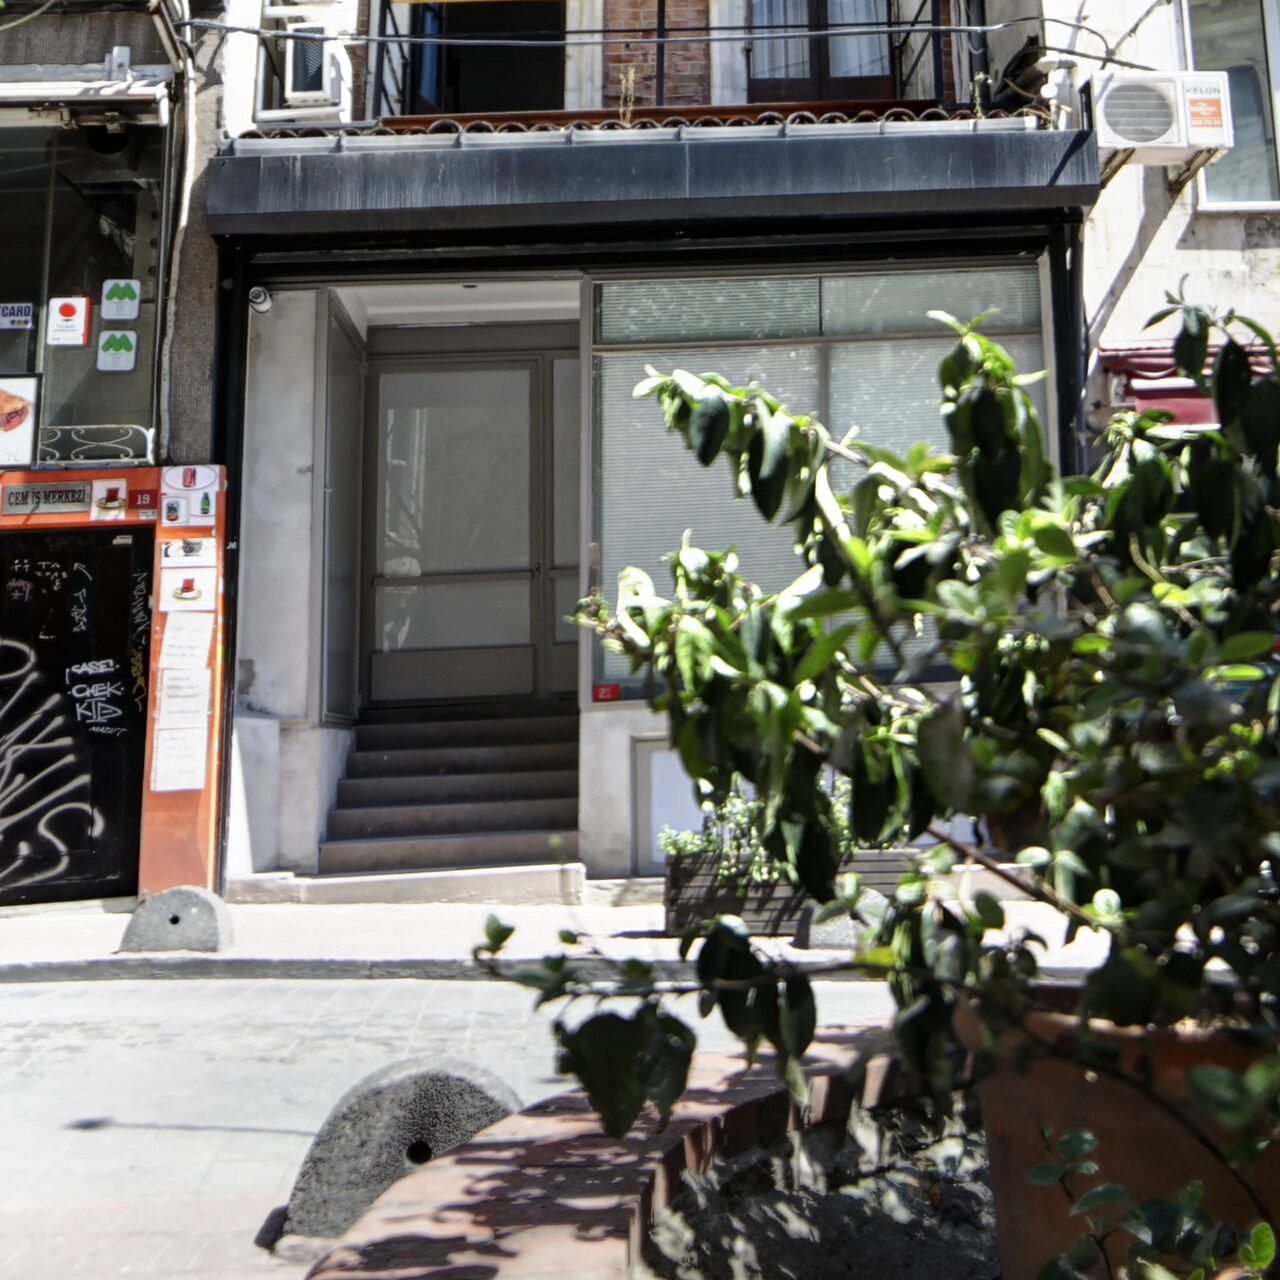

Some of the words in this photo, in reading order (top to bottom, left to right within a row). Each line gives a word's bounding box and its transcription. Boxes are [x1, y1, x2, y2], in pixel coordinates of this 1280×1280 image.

[7, 491, 29, 506] CEM
[43, 486, 86, 505] MERKEZİ
[136, 493, 151, 505] 19
